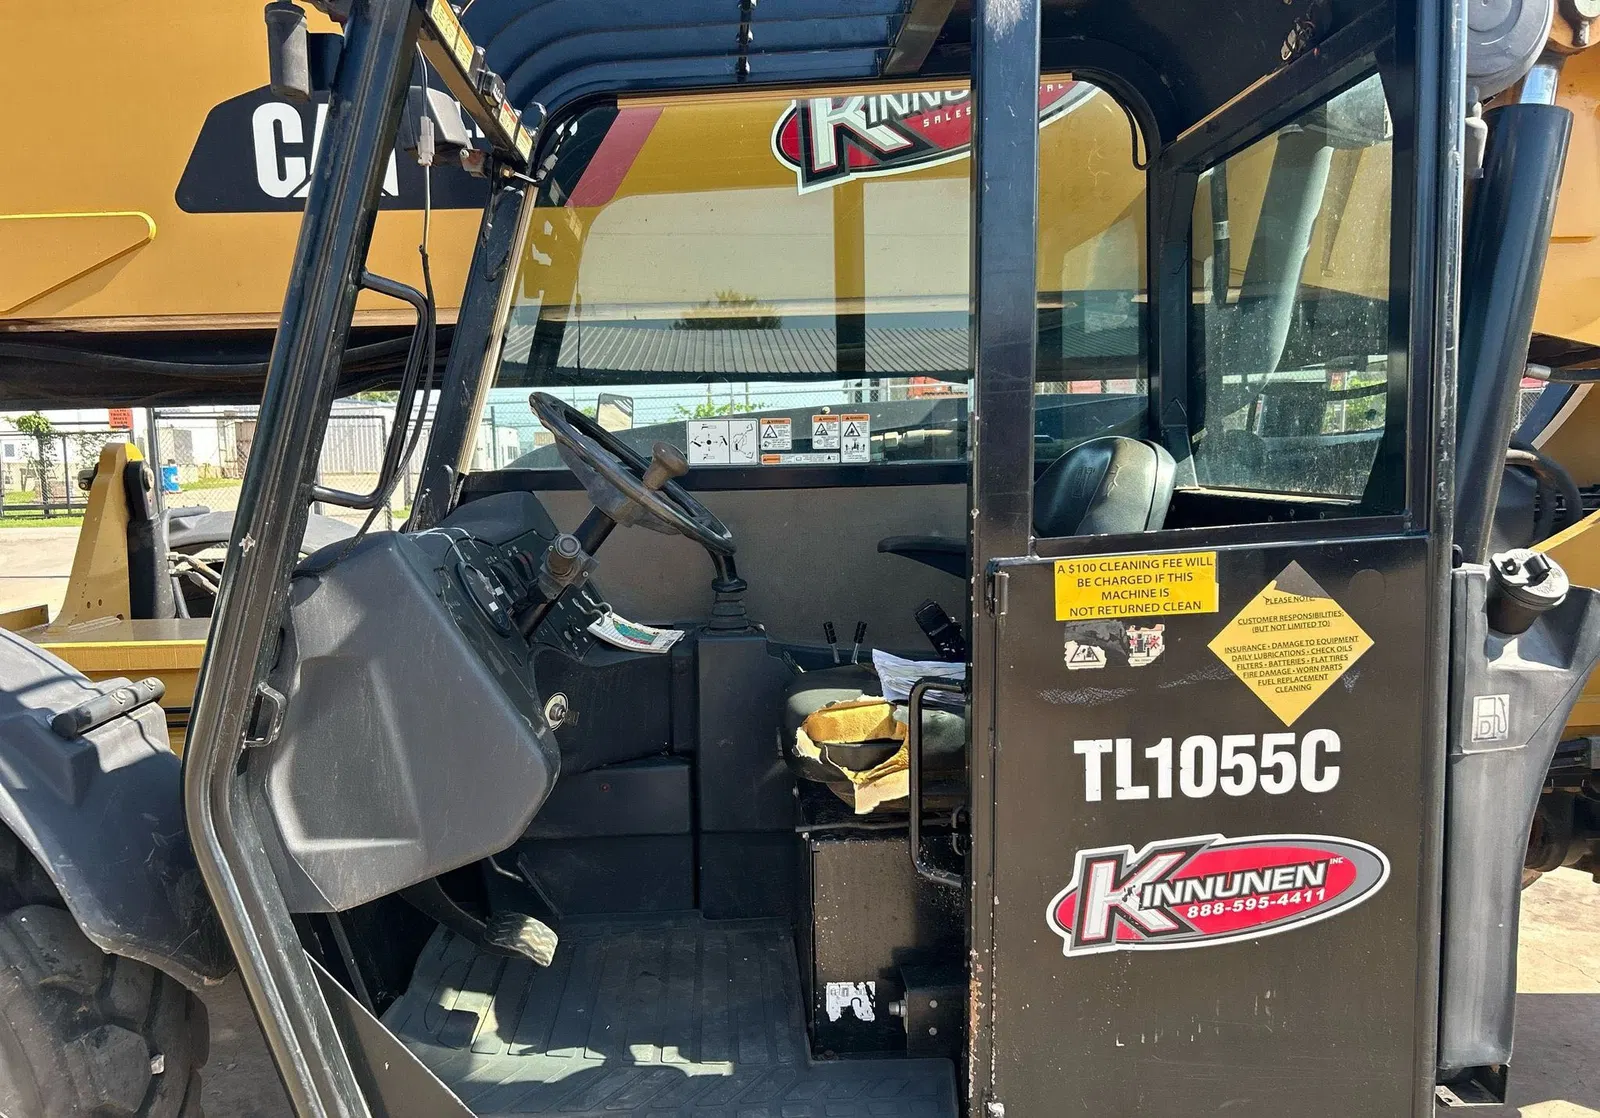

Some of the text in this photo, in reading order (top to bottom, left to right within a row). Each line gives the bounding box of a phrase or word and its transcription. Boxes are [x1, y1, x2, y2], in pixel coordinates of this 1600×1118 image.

[924, 106, 971, 127] SALES
[1057, 556, 1213, 574] A $100 CLEANING FEE WILL
[1077, 572, 1193, 587] BE CHARGED IF THIS
[1101, 588, 1169, 600] MACHINE IS
[1265, 597, 1292, 605] PLEASE
[1070, 601, 1201, 617] NOT RETURNED CLEAN
[1238, 610, 1344, 625] CUSTOMER RESPONSIBILITIES:
[1252, 620, 1330, 633] (BUT NOT LIMITED TO)
[1224, 644, 1266, 653] INSURANCE
[1272, 640, 1304, 650] DAMAGE
[1316, 636, 1358, 645] EQUIPMENT
[1232, 654, 1252, 662] DAILY
[1254, 649, 1306, 660] LUBRICATIONS
[1311, 647, 1334, 655] CHECK
[1236, 654, 1348, 670] FILTERS BATTERIES FLAT TIRES
[1260, 668, 1292, 678] DAMAGE
[1296, 666, 1319, 674] WORN
[1320, 664, 1342, 672] PARTS
[1276, 674, 1328, 684] REPLACEMENT
[1274, 684, 1312, 694] CLEANING
[1073, 728, 1341, 802] TL1055C
[1080, 850, 1344, 942] KINNUNEN INC
[1187, 888, 1327, 919] 888-595-4411
